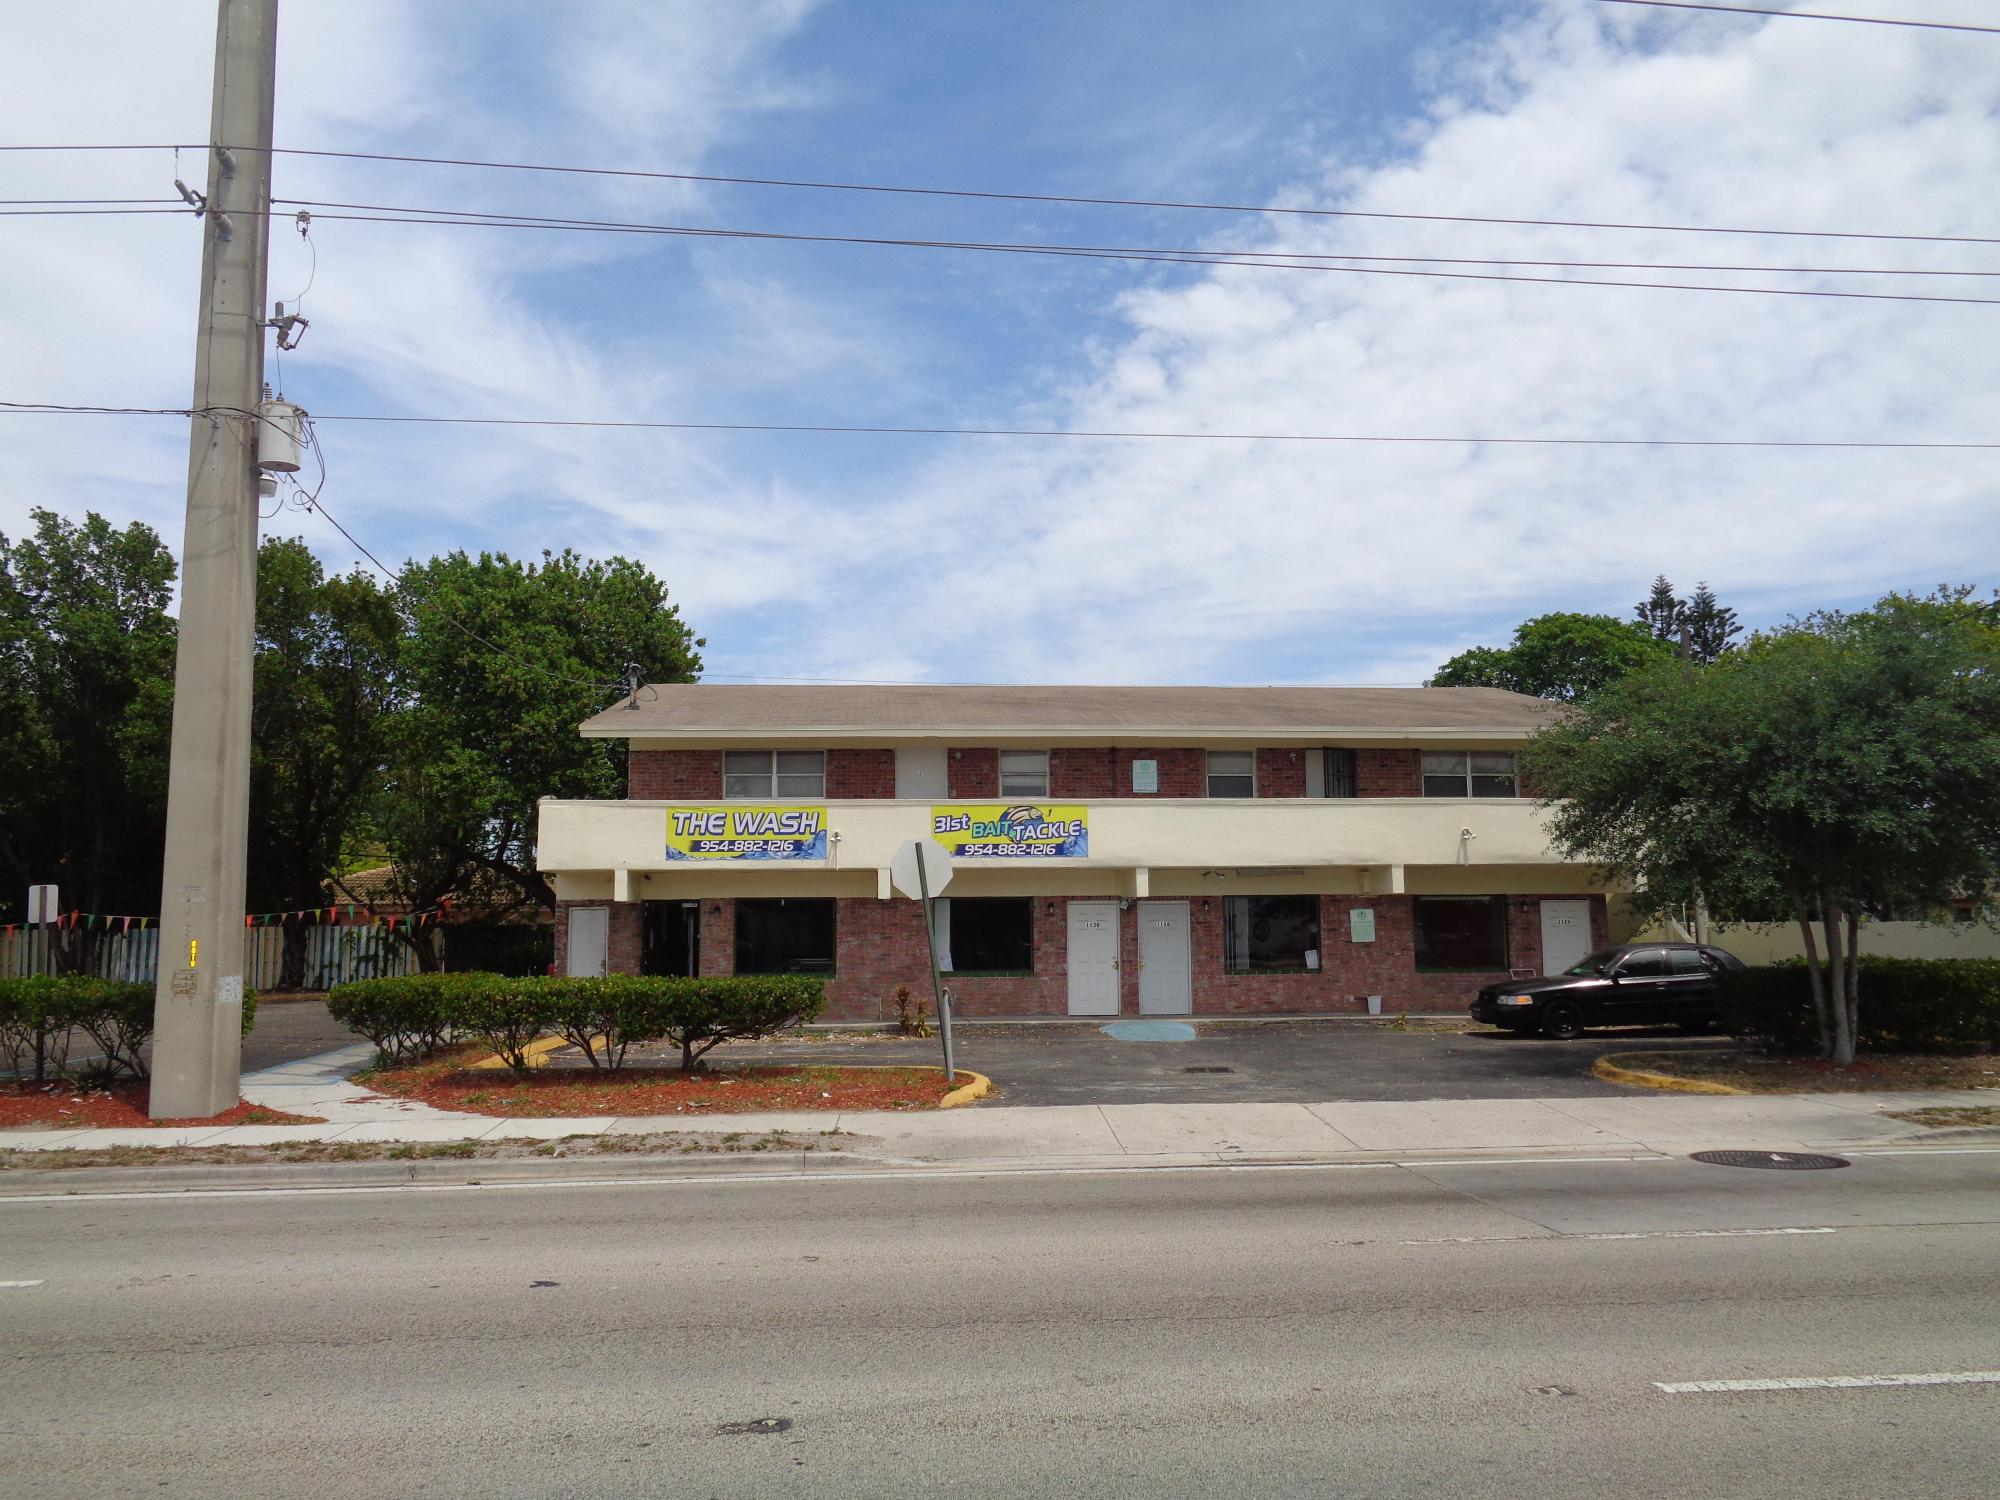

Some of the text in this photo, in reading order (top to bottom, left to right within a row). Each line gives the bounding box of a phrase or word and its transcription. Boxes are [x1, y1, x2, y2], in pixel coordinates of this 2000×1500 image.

[672, 811, 820, 836] THE WASH
[934, 813, 1083, 841] 31st BAIT TACKLE
[700, 840, 794, 852] 954-882-1216
[964, 843, 1057, 856] 954-882-1216
